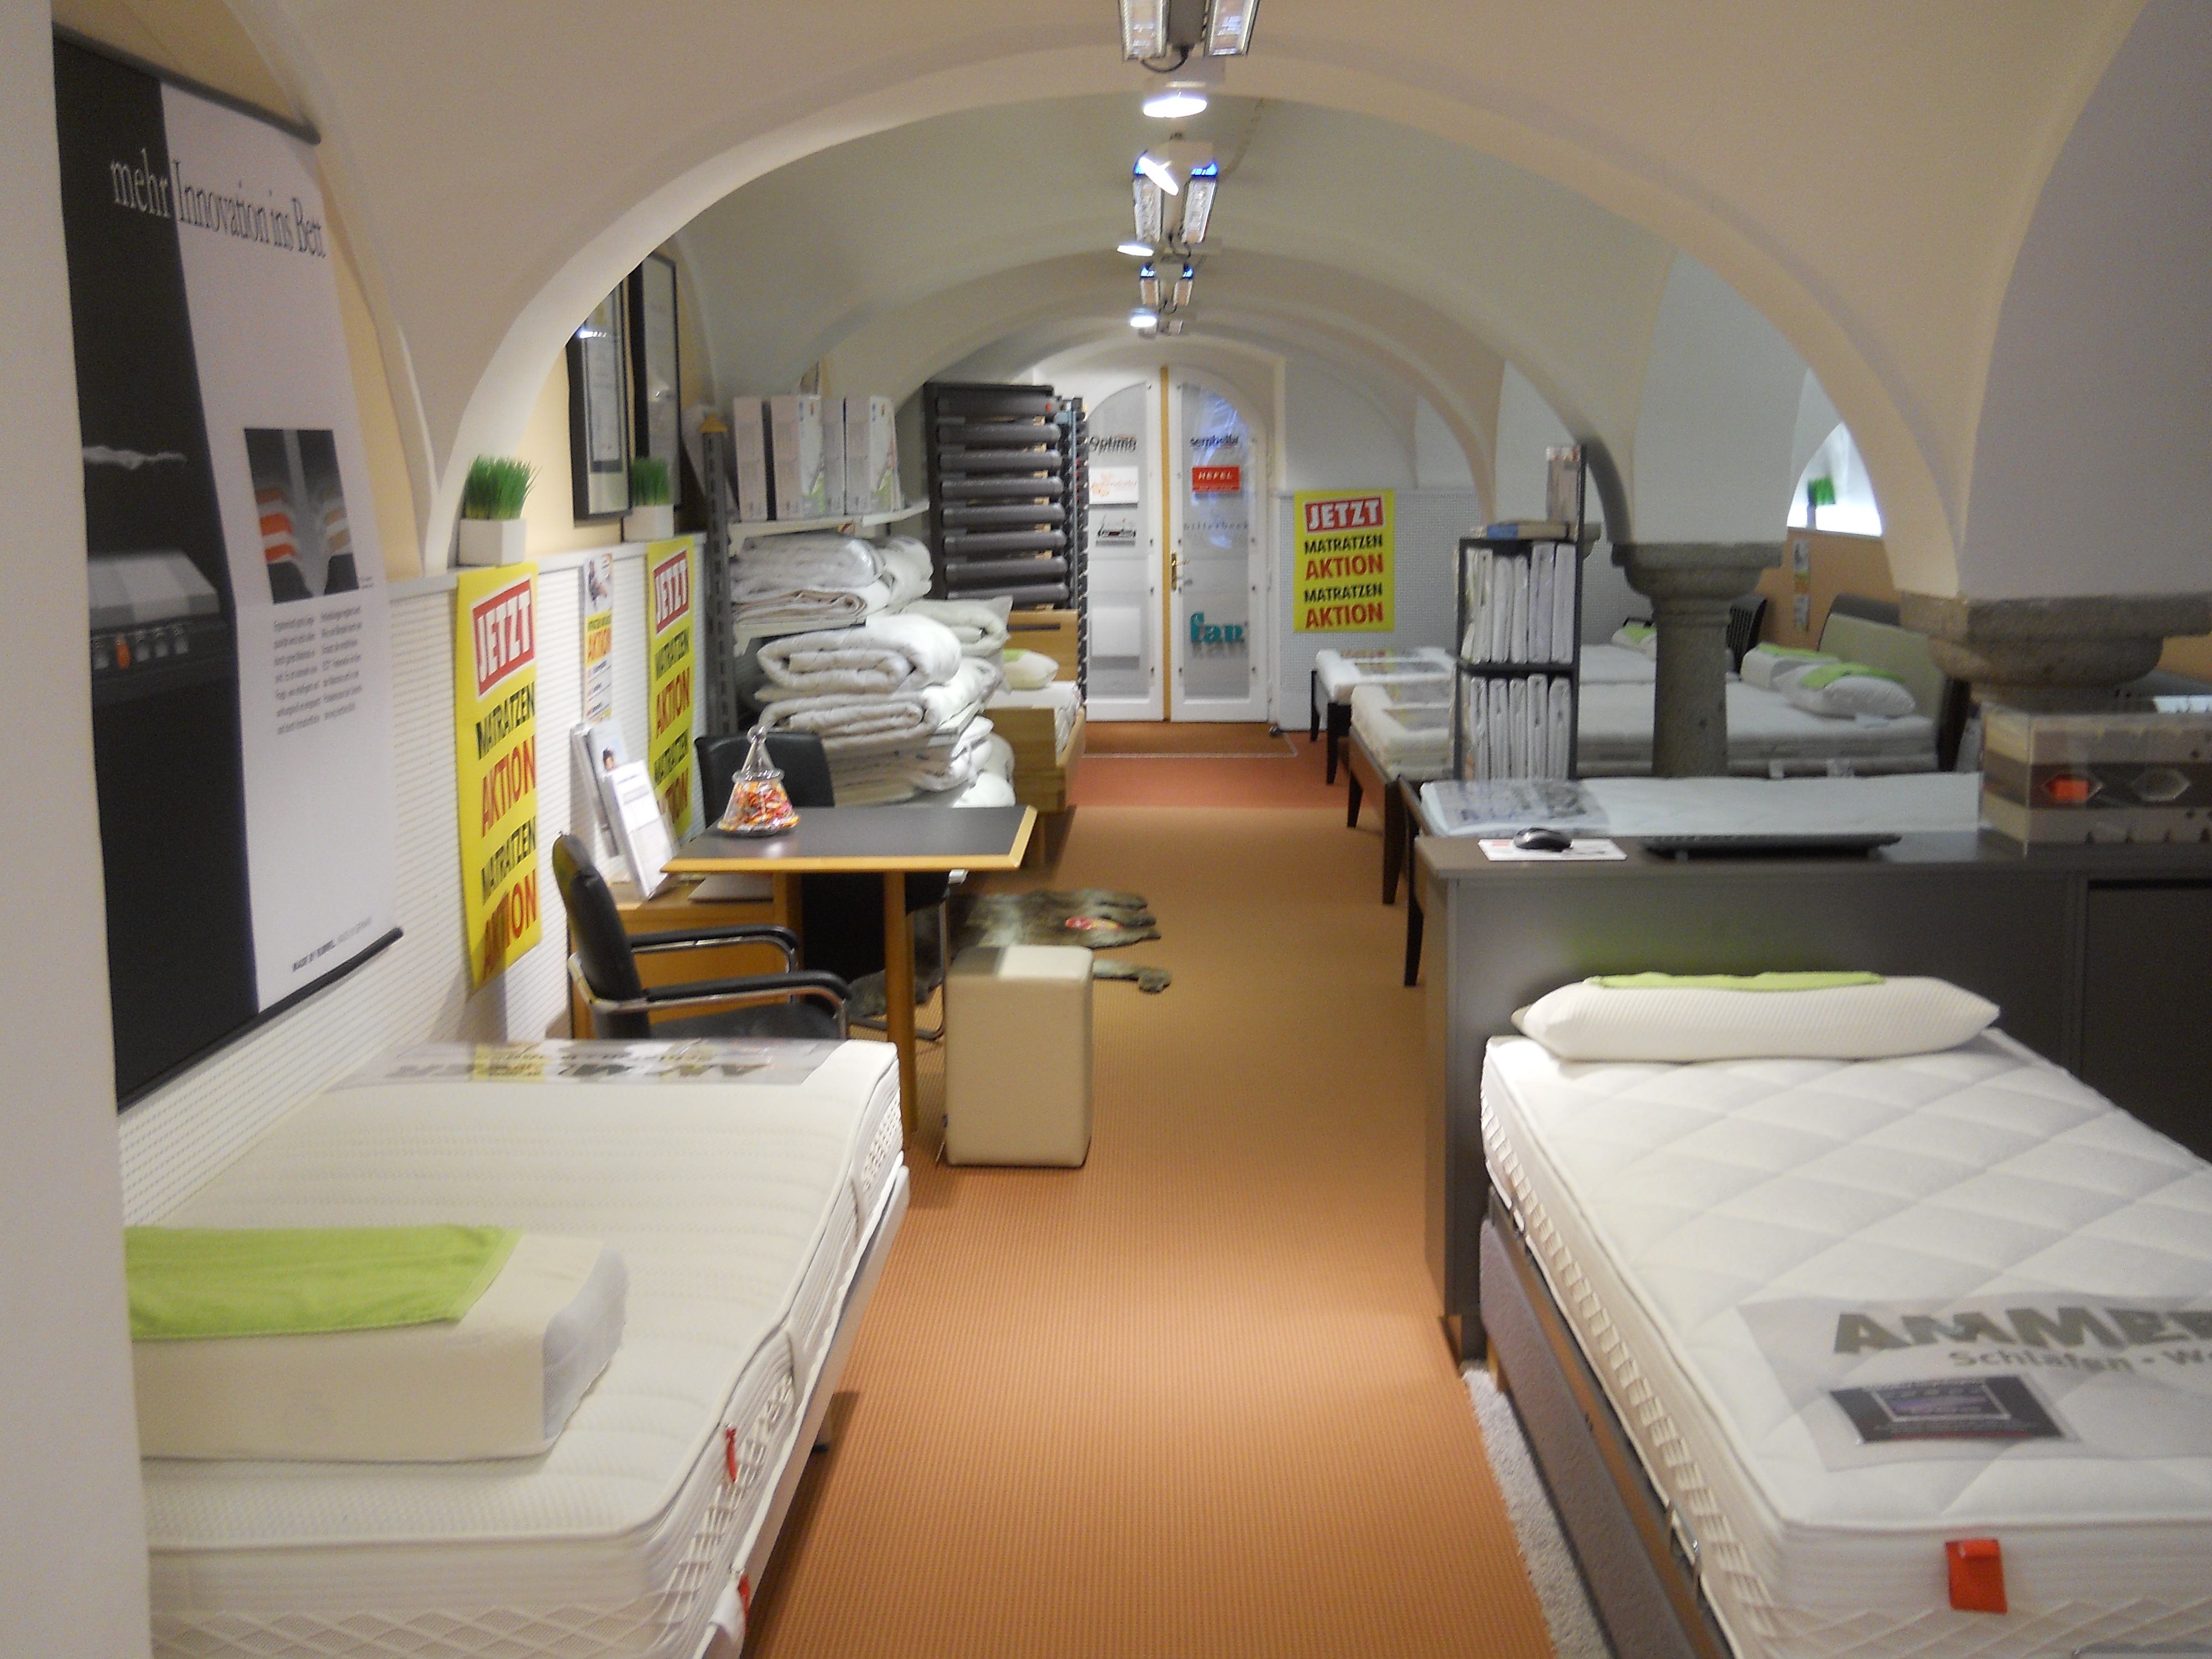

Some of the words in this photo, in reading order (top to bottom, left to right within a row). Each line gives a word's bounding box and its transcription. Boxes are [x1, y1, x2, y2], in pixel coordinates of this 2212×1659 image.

[111, 148, 173, 219] mehr
[173, 158, 270, 244] Innovation
[269, 189, 294, 251] ins
[1305, 533, 1383, 555] MATRATZEN
[1308, 499, 1380, 530] JETZT
[655, 559, 687, 625] JETZT
[1305, 583, 1383, 604] MATRATZEN
[1306, 553, 1383, 581] AKTION
[477, 589, 530, 683] JETZT
[1306, 602, 1384, 629] AKTION
[656, 627, 690, 681] MATRATZEN
[476, 681, 535, 760] MATRATZEN
[656, 666, 691, 740] AKTION
[483, 734, 536, 838] AKTION
[654, 728, 690, 786] MATRATZEN
[481, 816, 536, 906] MATRATZEN
[483, 867, 537, 980] AKTION
